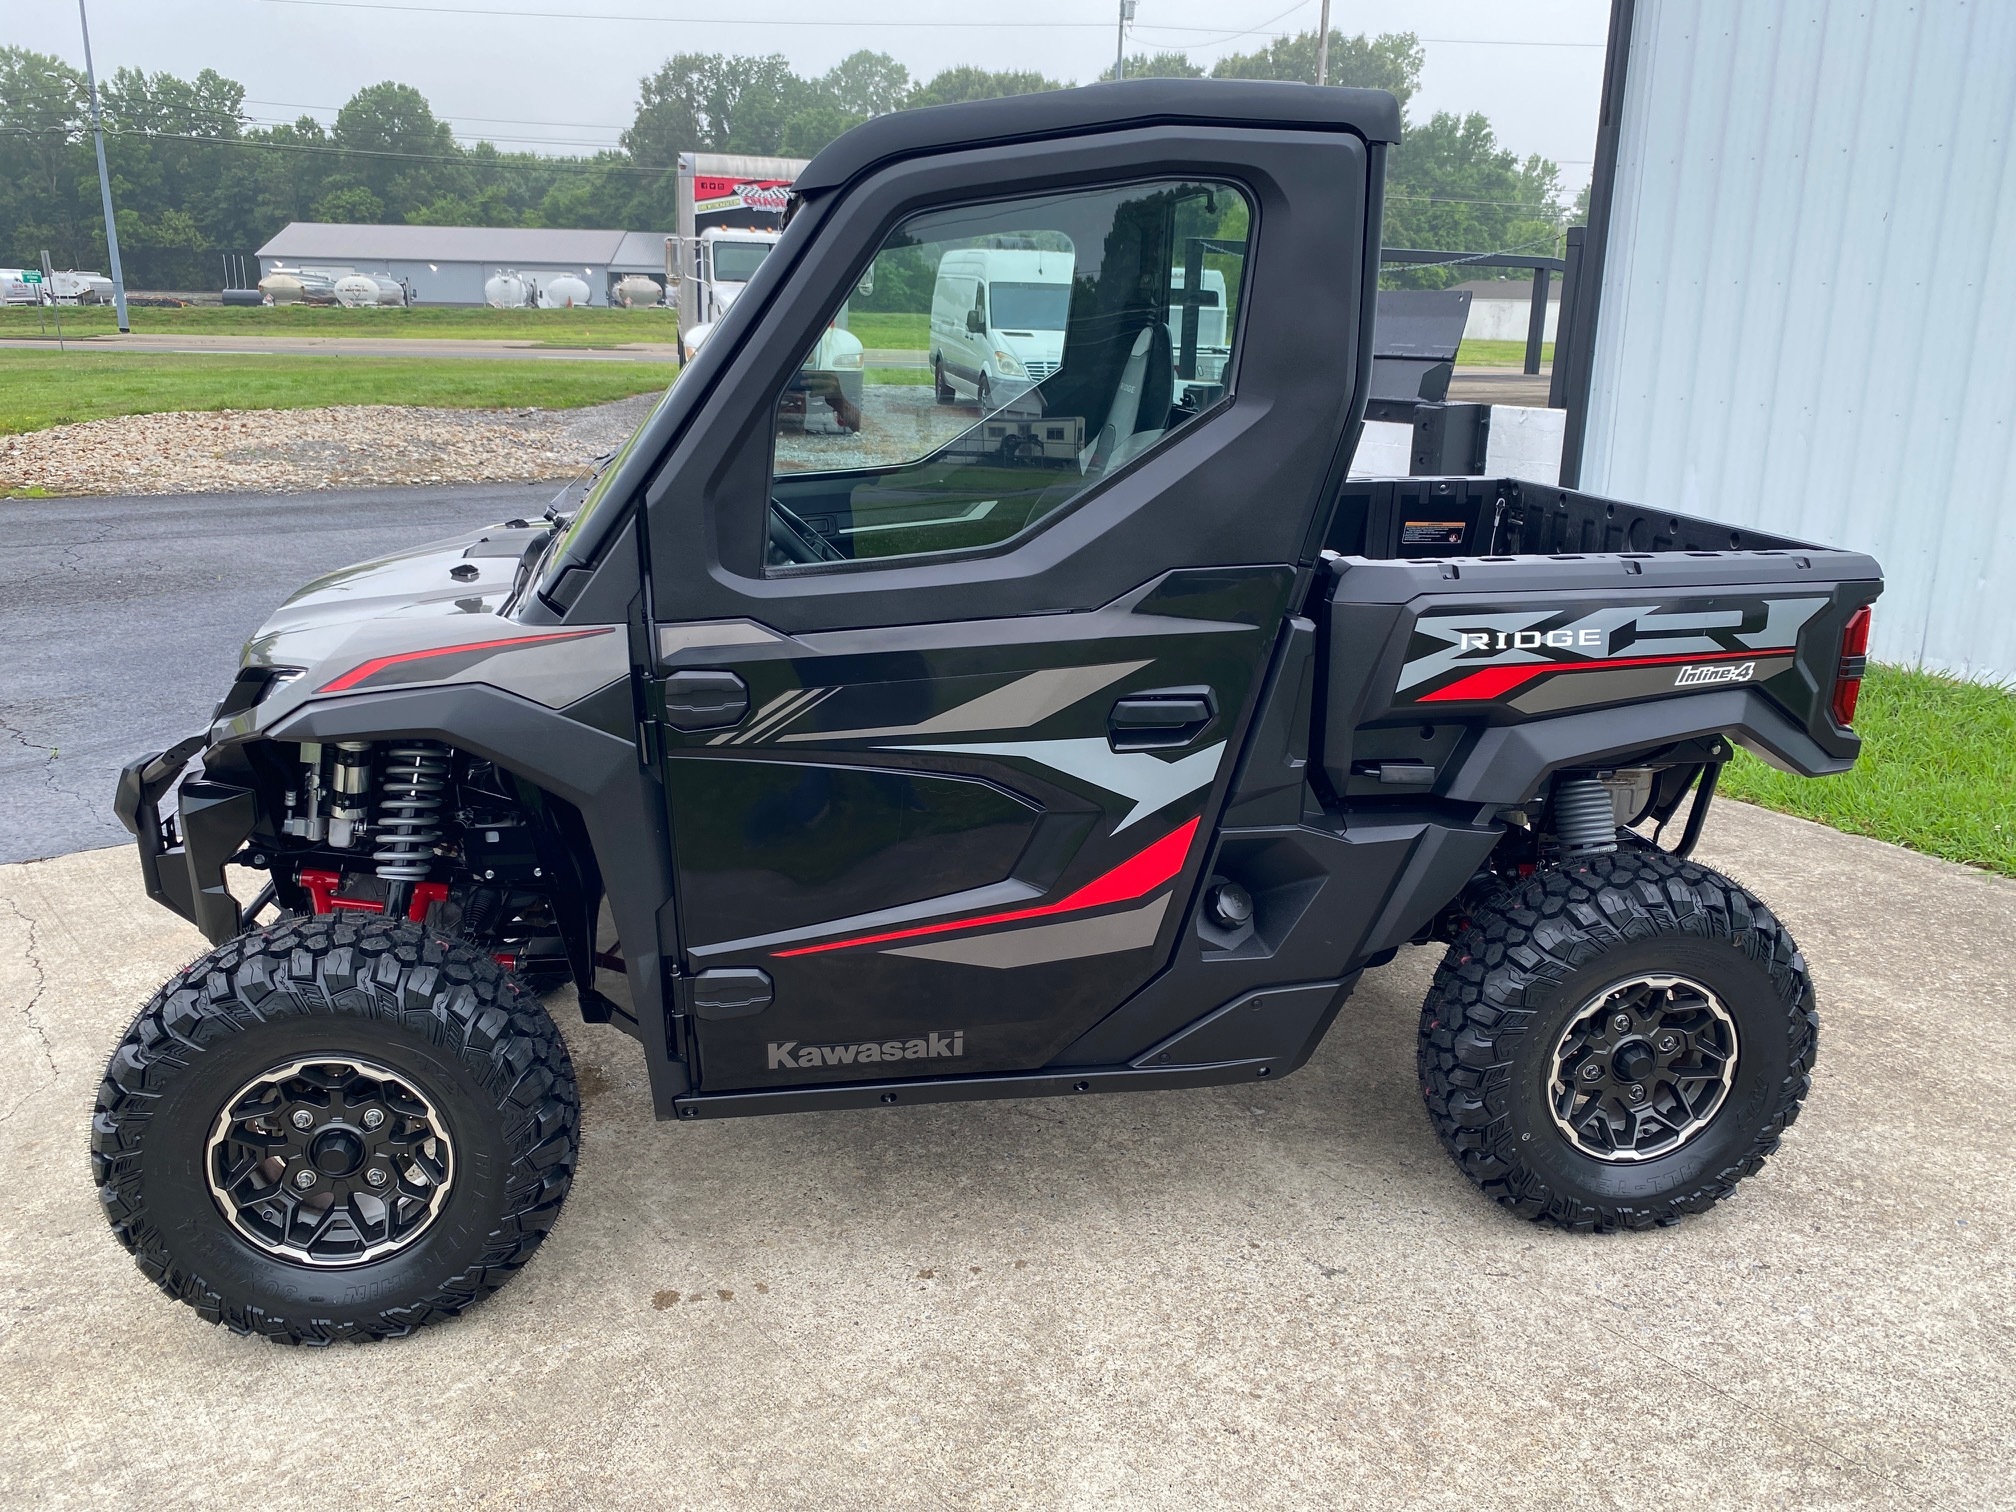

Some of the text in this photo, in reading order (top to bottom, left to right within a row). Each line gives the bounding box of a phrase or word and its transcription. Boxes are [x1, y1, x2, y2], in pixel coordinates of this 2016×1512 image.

[1461, 629, 1601, 650] RIDGE
[1675, 662, 1755, 685] Inline-4
[767, 1030, 964, 1070] Kawasaki
